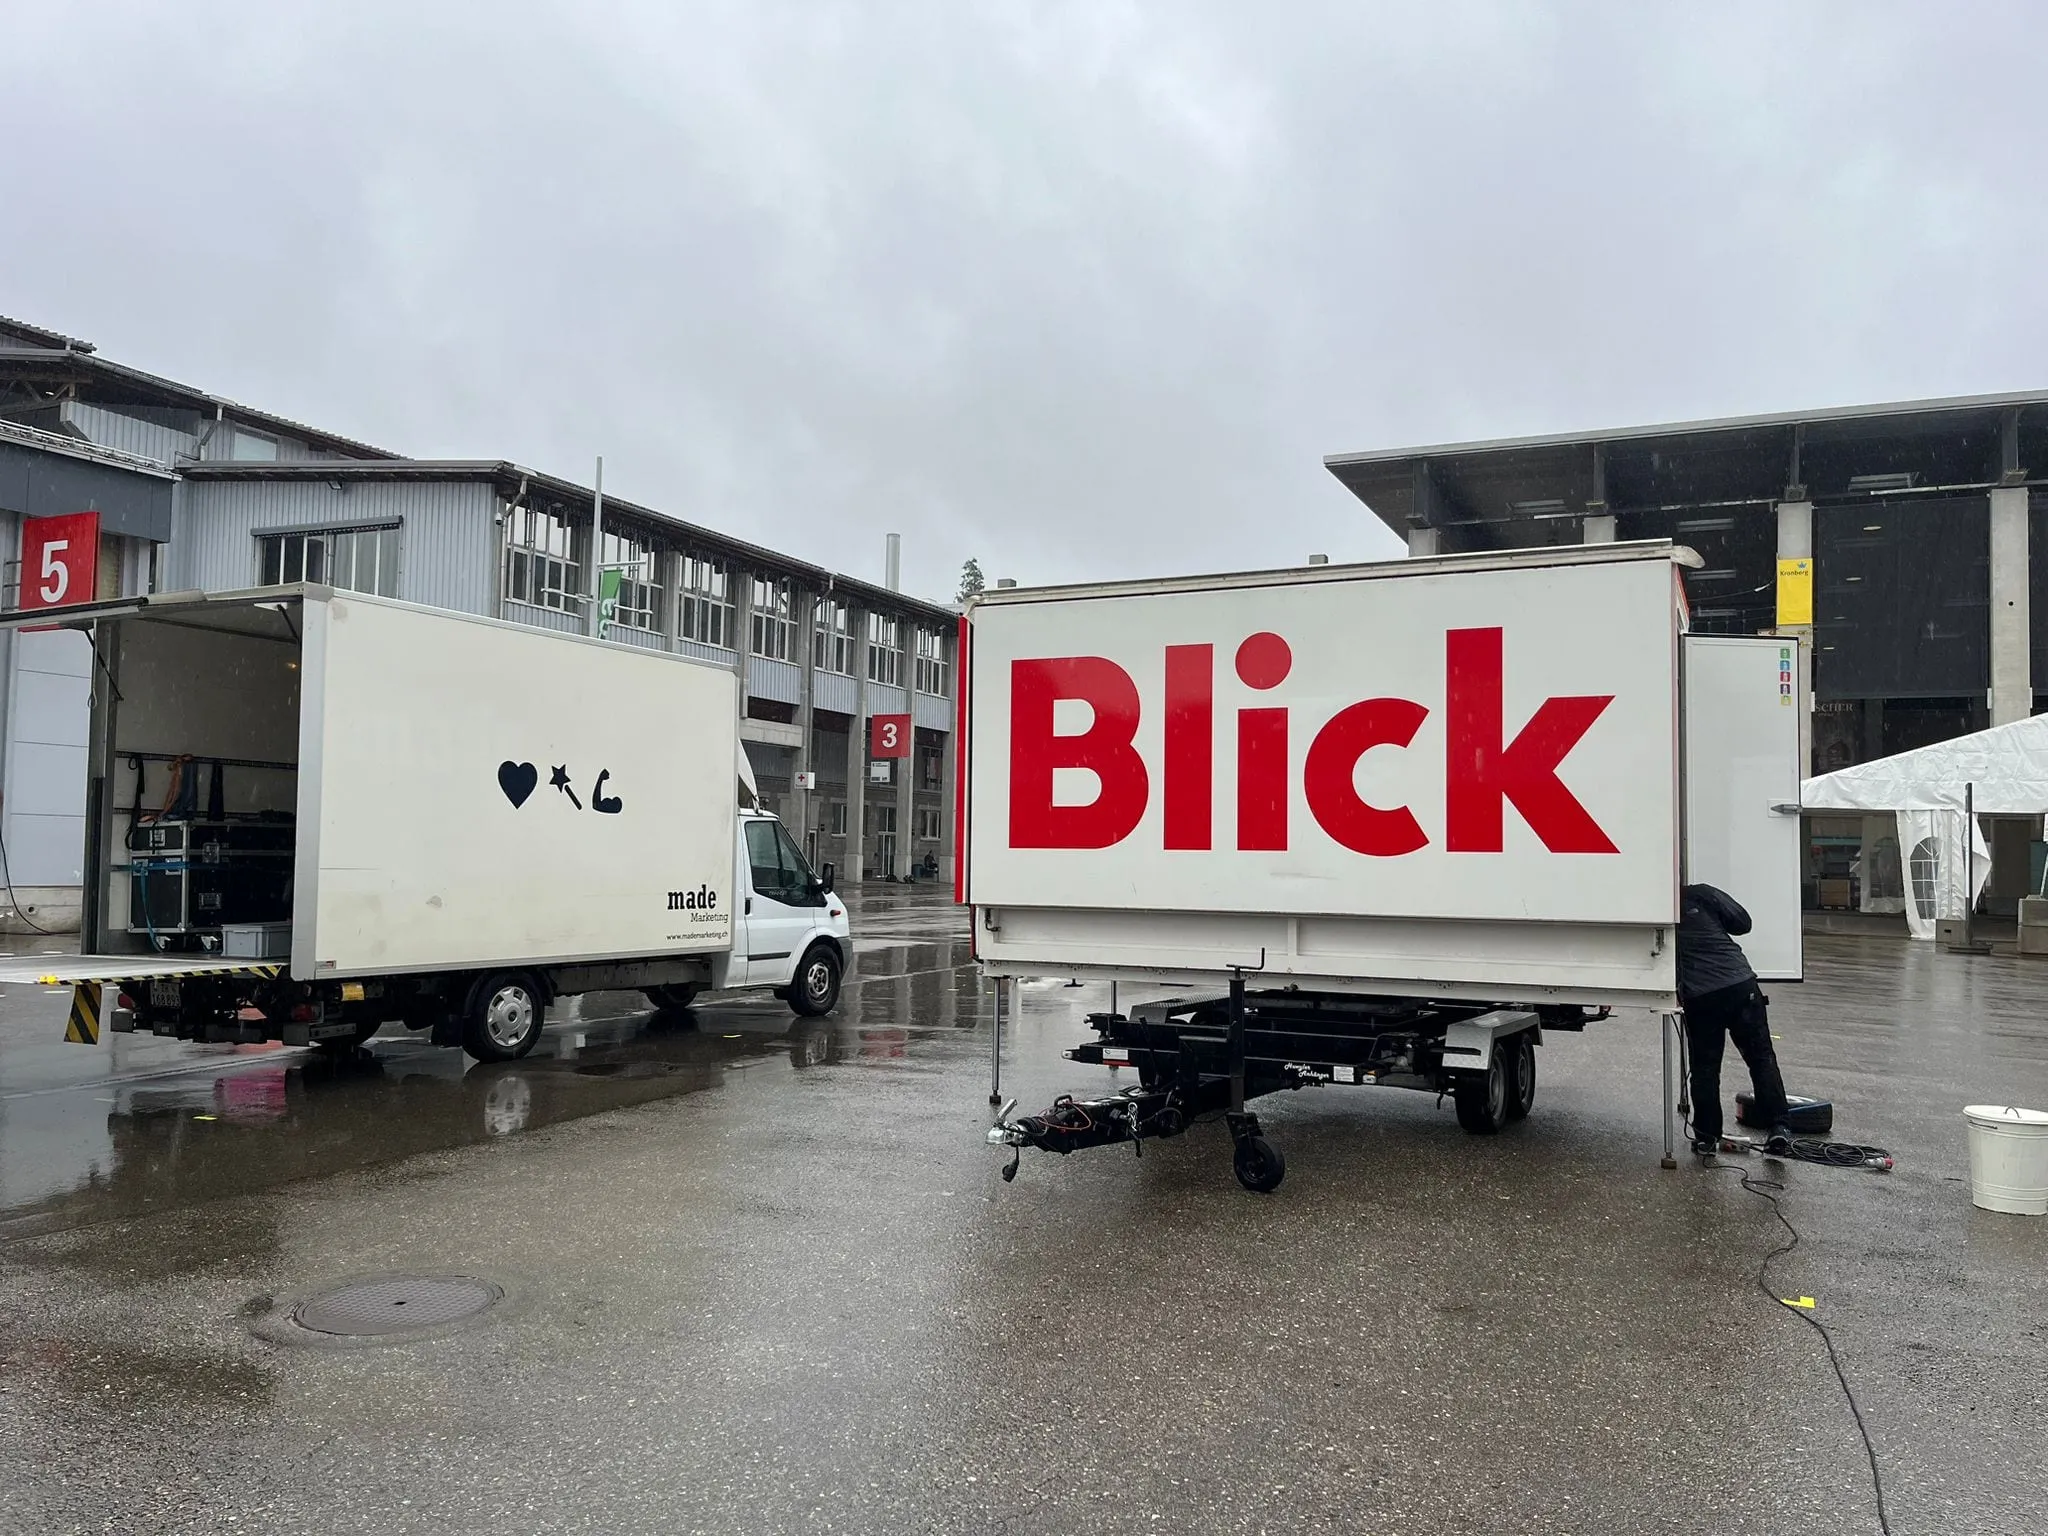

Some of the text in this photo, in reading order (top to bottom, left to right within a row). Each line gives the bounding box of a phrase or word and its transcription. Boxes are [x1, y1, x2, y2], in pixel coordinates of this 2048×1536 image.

[40, 539, 69, 603] 5
[1780, 569, 1809, 577] Kronberg
[882, 723, 897, 748] 3
[1009, 627, 1619, 857] Blick
[667, 884, 716, 910] made
[690, 912, 728, 923] Marketing
